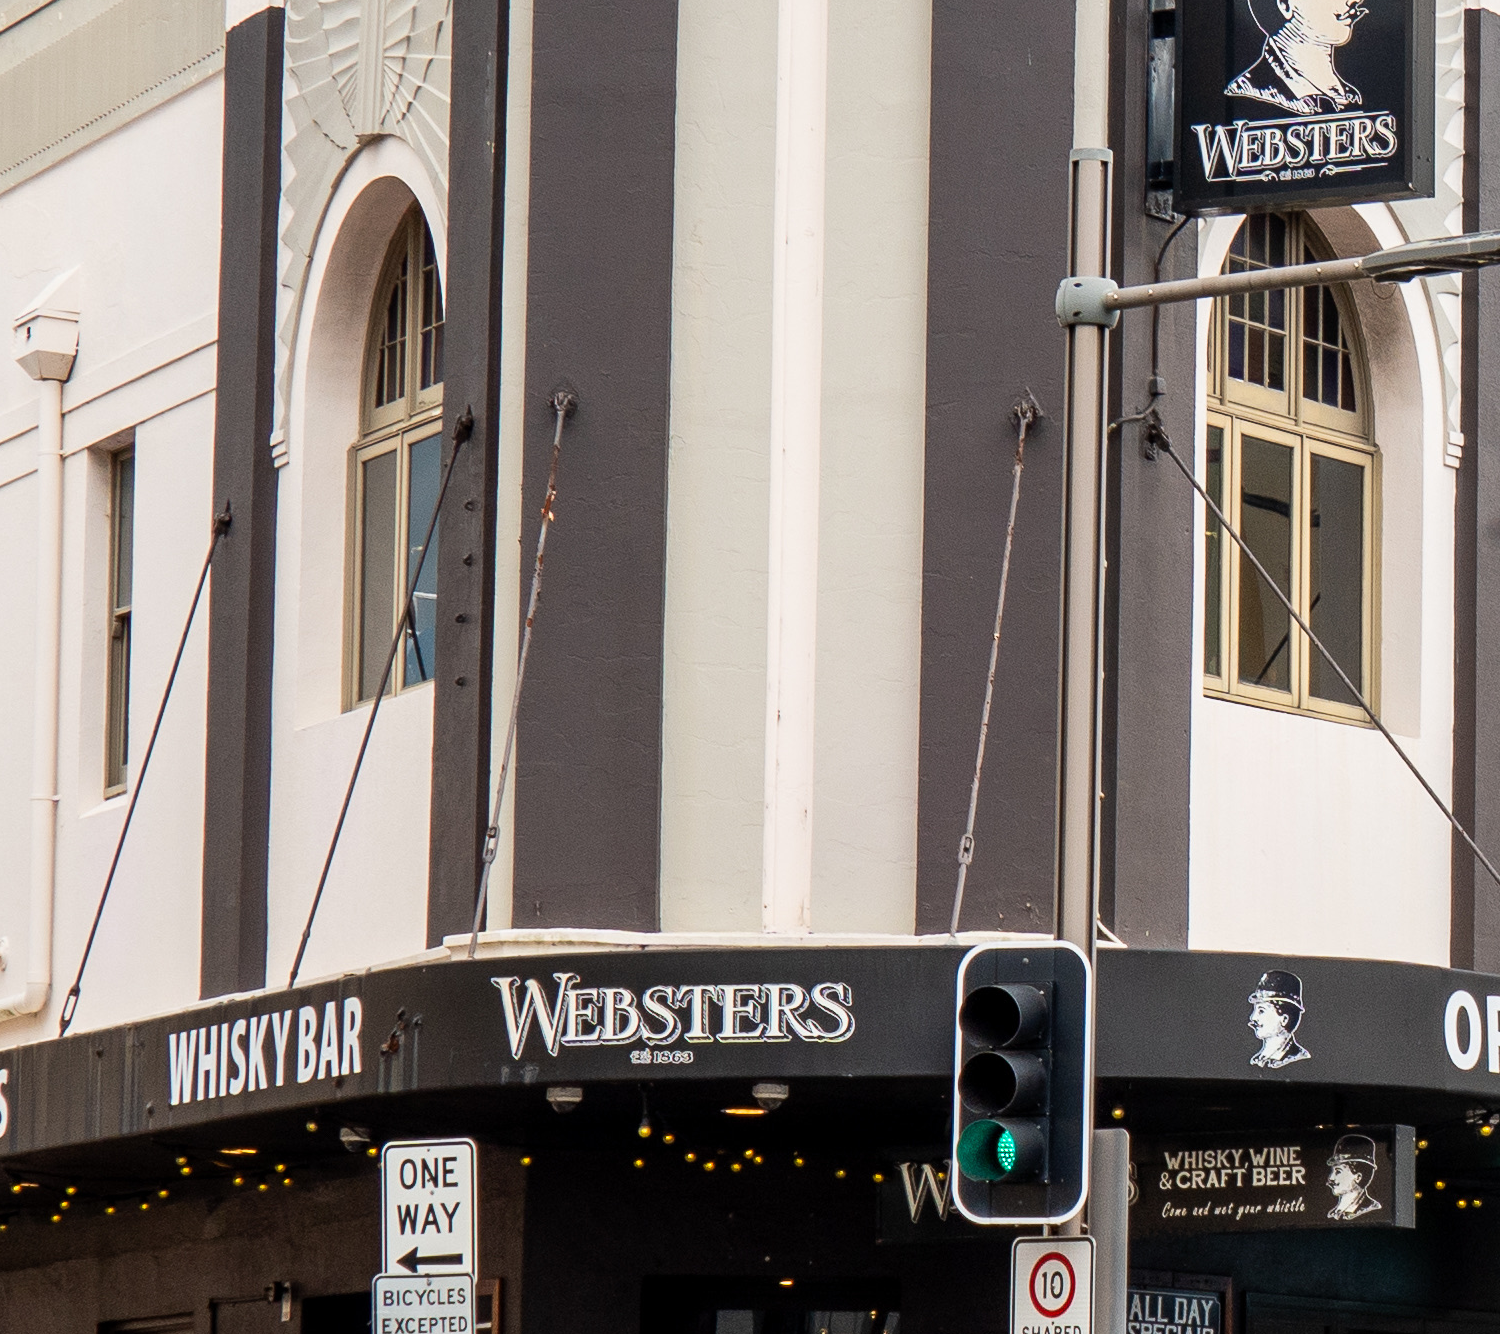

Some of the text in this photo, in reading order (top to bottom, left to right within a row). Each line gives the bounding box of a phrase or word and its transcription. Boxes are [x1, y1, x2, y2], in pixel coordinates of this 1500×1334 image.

[1191, 114, 1398, 182] WEBSTERS
[491, 972, 856, 1061] WEBSTERS
[169, 996, 364, 1106] WHISKY BAR
[653, 1049, 695, 1065] 1863
[1250, 1146, 1302, 1166] WINE
[399, 1156, 459, 1190] ONE
[1159, 1166, 1306, 1191] & CRAFT BEER
[396, 1202, 461, 1236] WAY
[1162, 1197, 1306, 1220] Come and wet your whistle
[382, 1287, 467, 1308] BICYCLES
[1041, 1270, 1064, 1301] 10
[381, 1315, 468, 1334] EXCEPTED
[1129, 1294, 1214, 1327] ALL DAY
